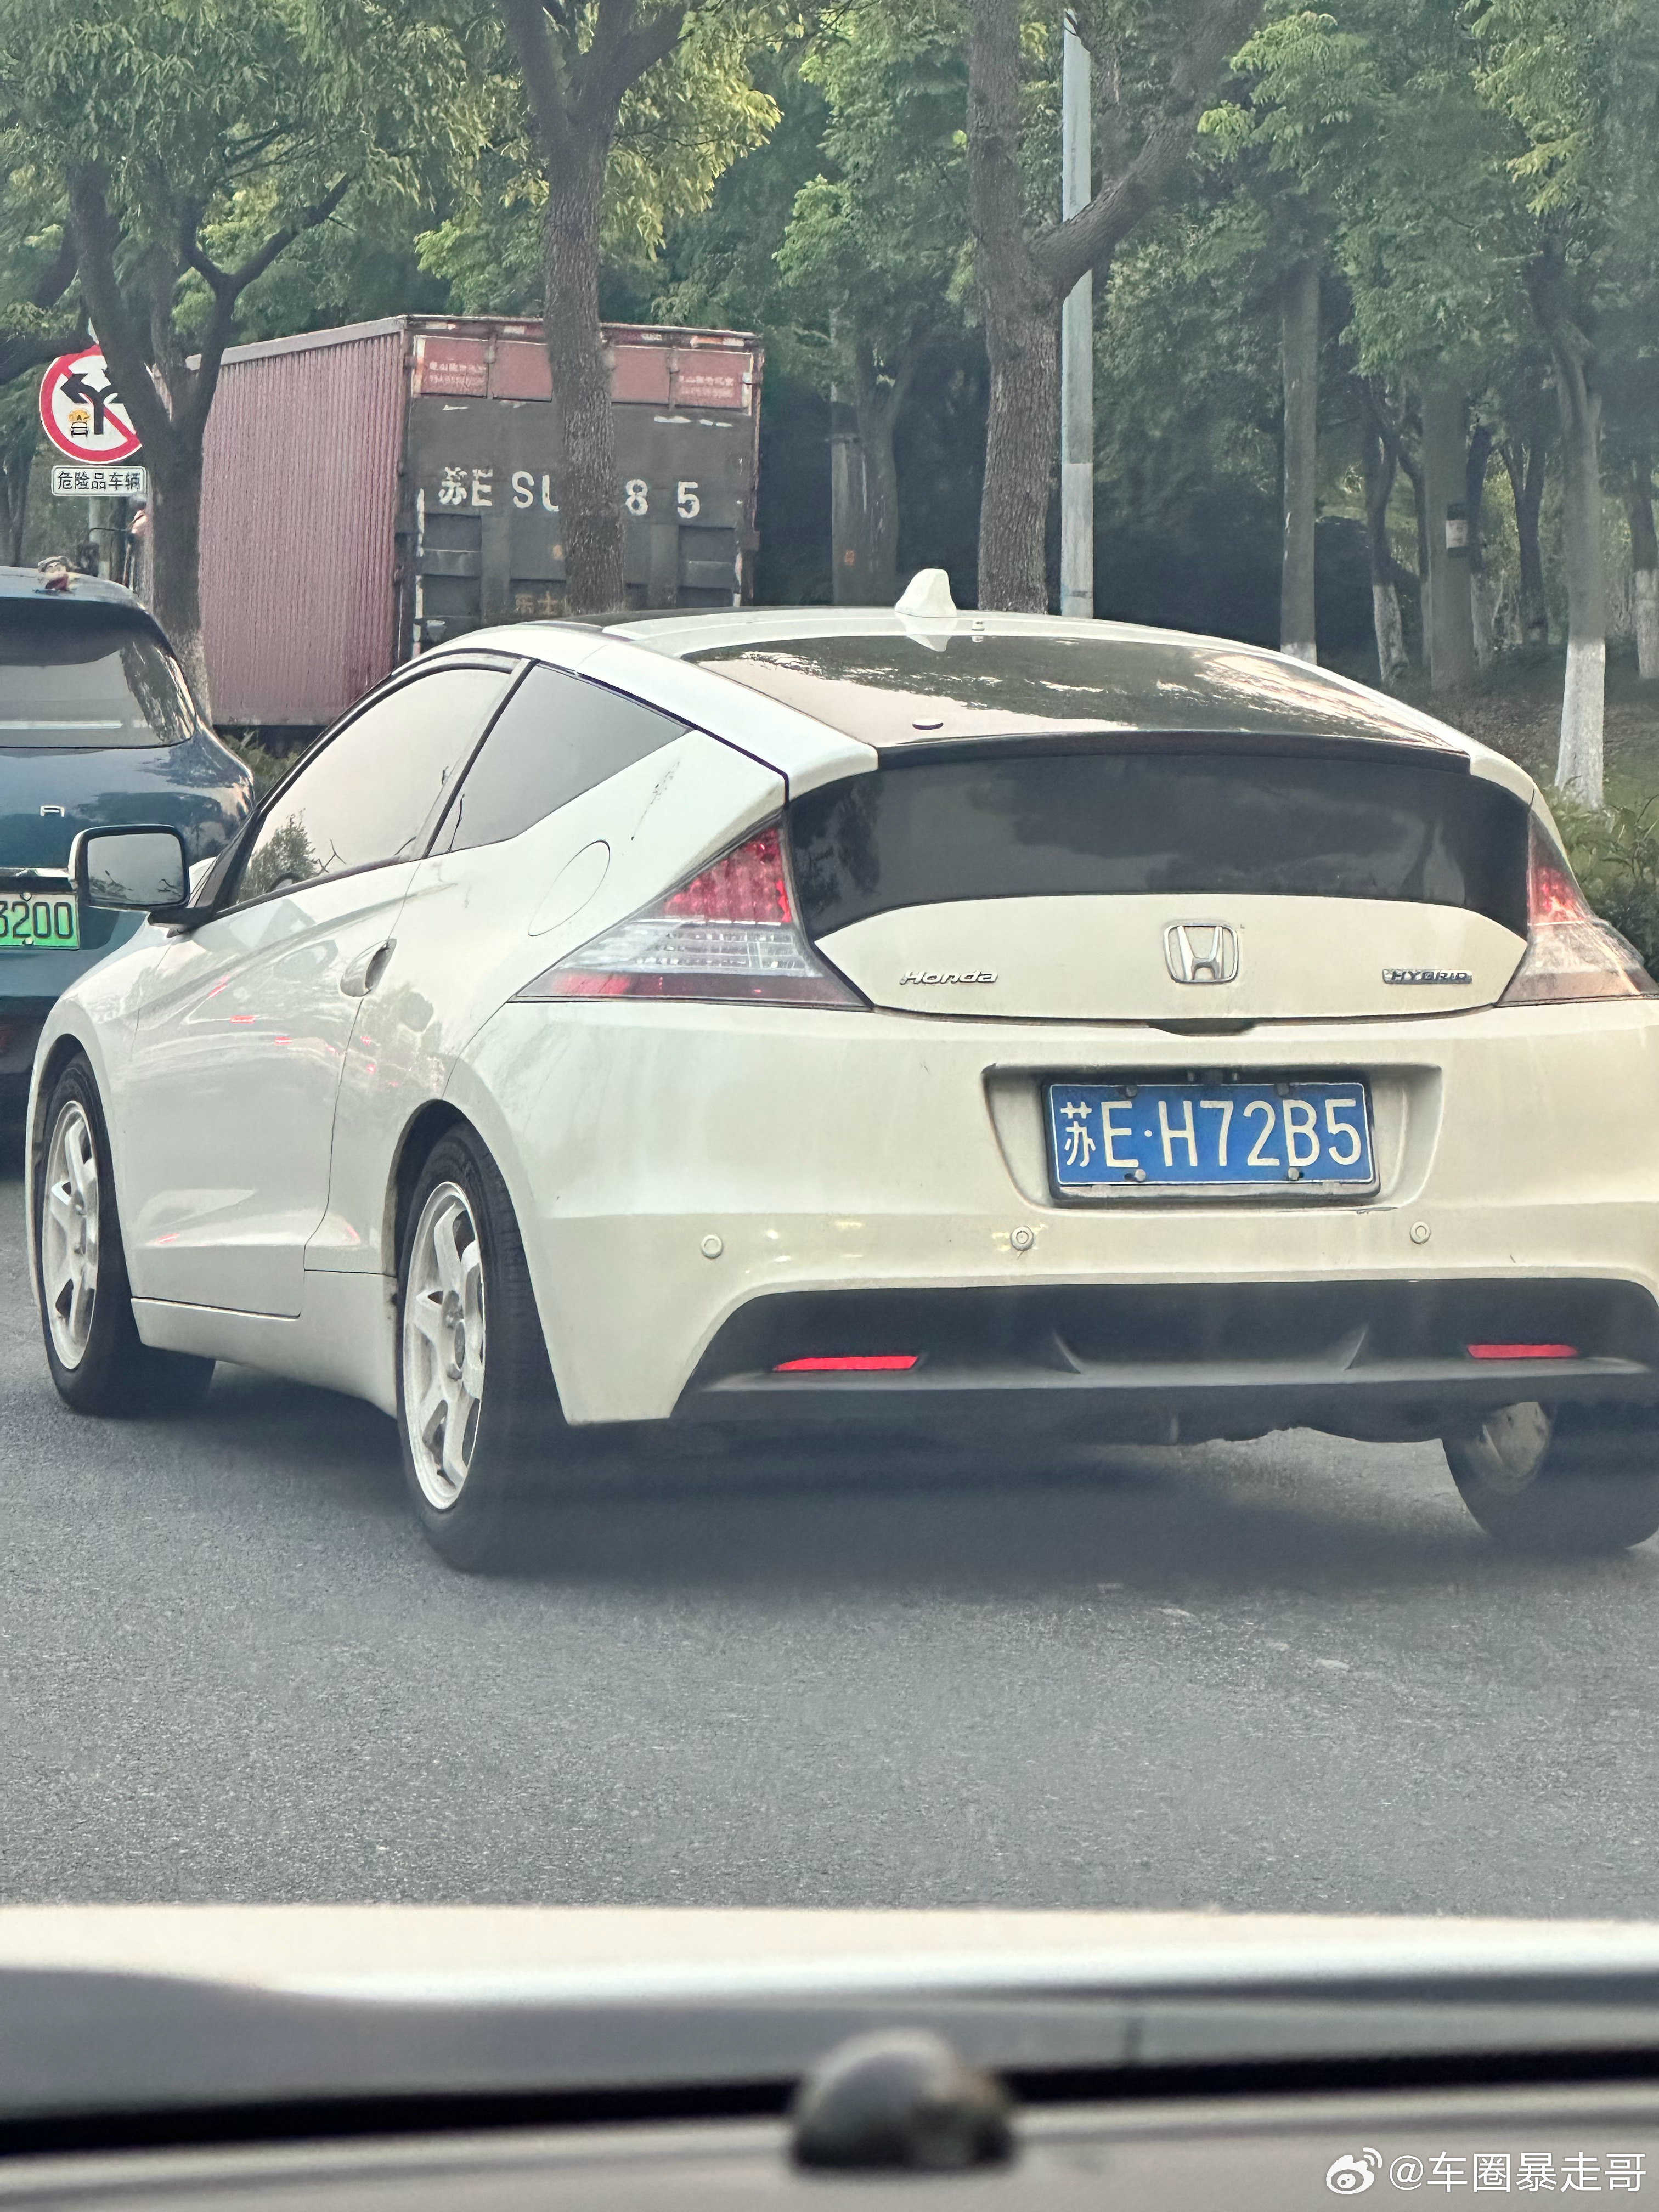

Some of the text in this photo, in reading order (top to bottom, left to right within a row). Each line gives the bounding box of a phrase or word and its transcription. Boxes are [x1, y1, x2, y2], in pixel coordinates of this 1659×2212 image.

[57, 471, 141, 491] 危险品车辆
[899, 970, 998, 985] Honda
[1390, 969, 1469, 982] HYBRID
